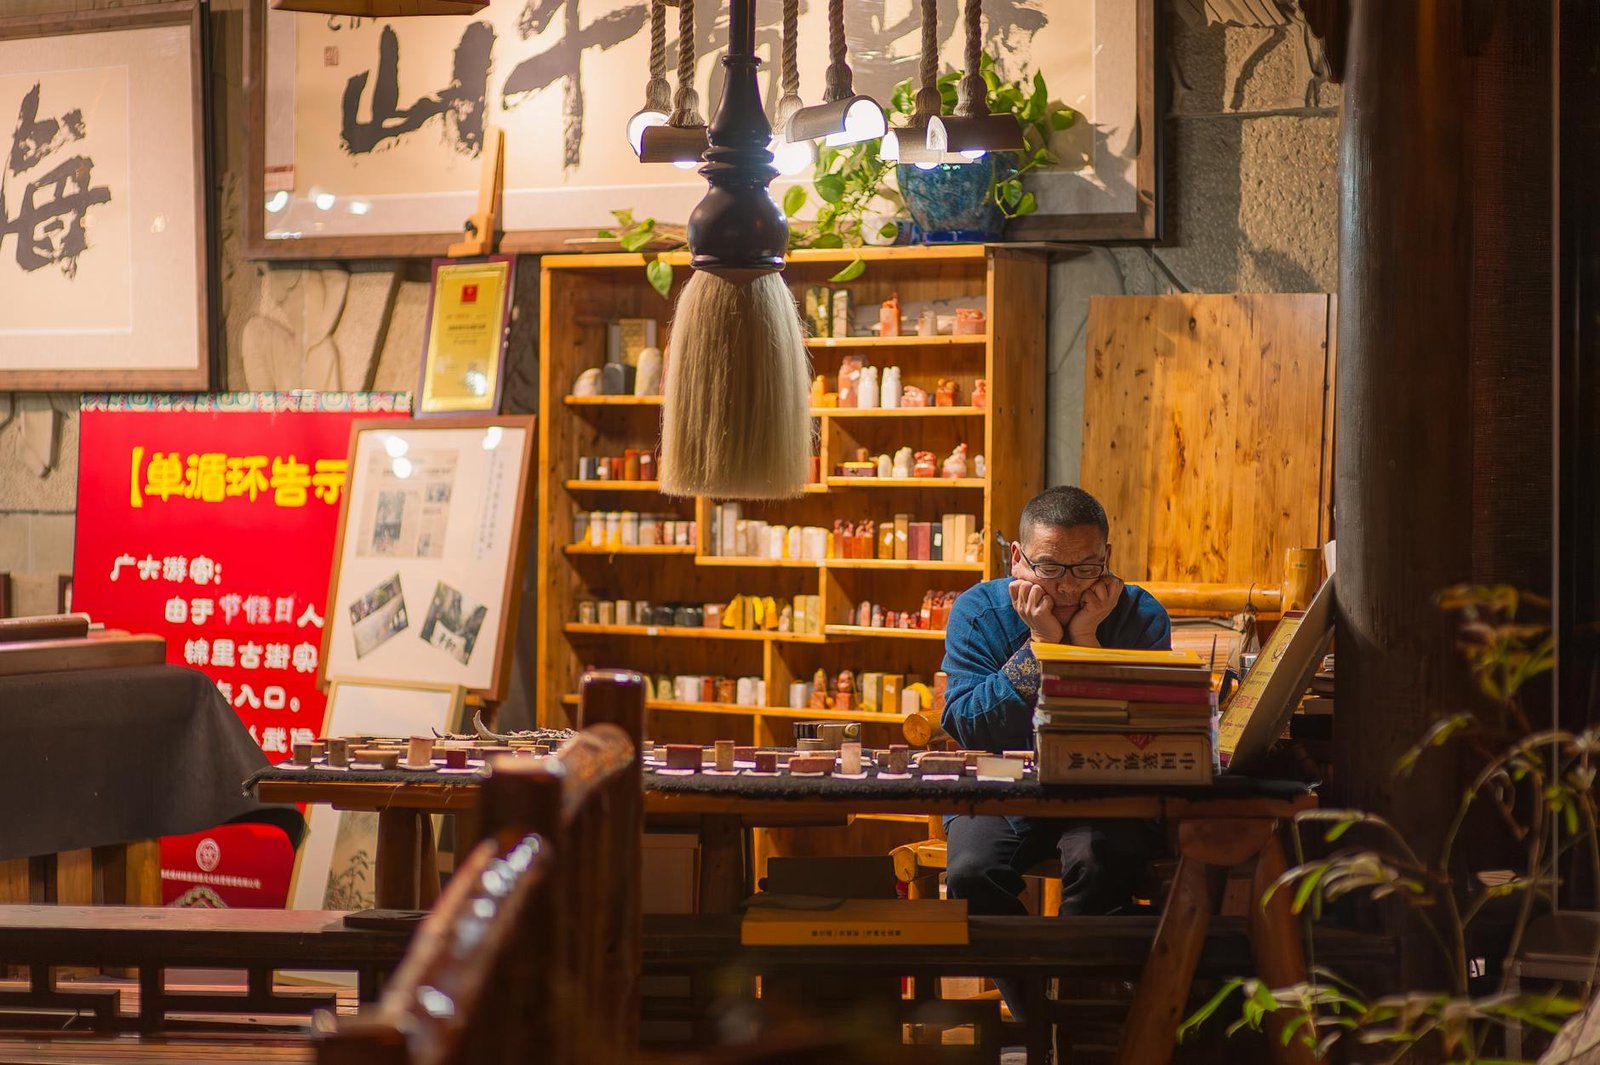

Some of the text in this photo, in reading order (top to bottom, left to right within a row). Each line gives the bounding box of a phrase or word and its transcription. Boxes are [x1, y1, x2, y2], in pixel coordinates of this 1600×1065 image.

[1068, 752, 1196, 770] 中国篆刻大字典
